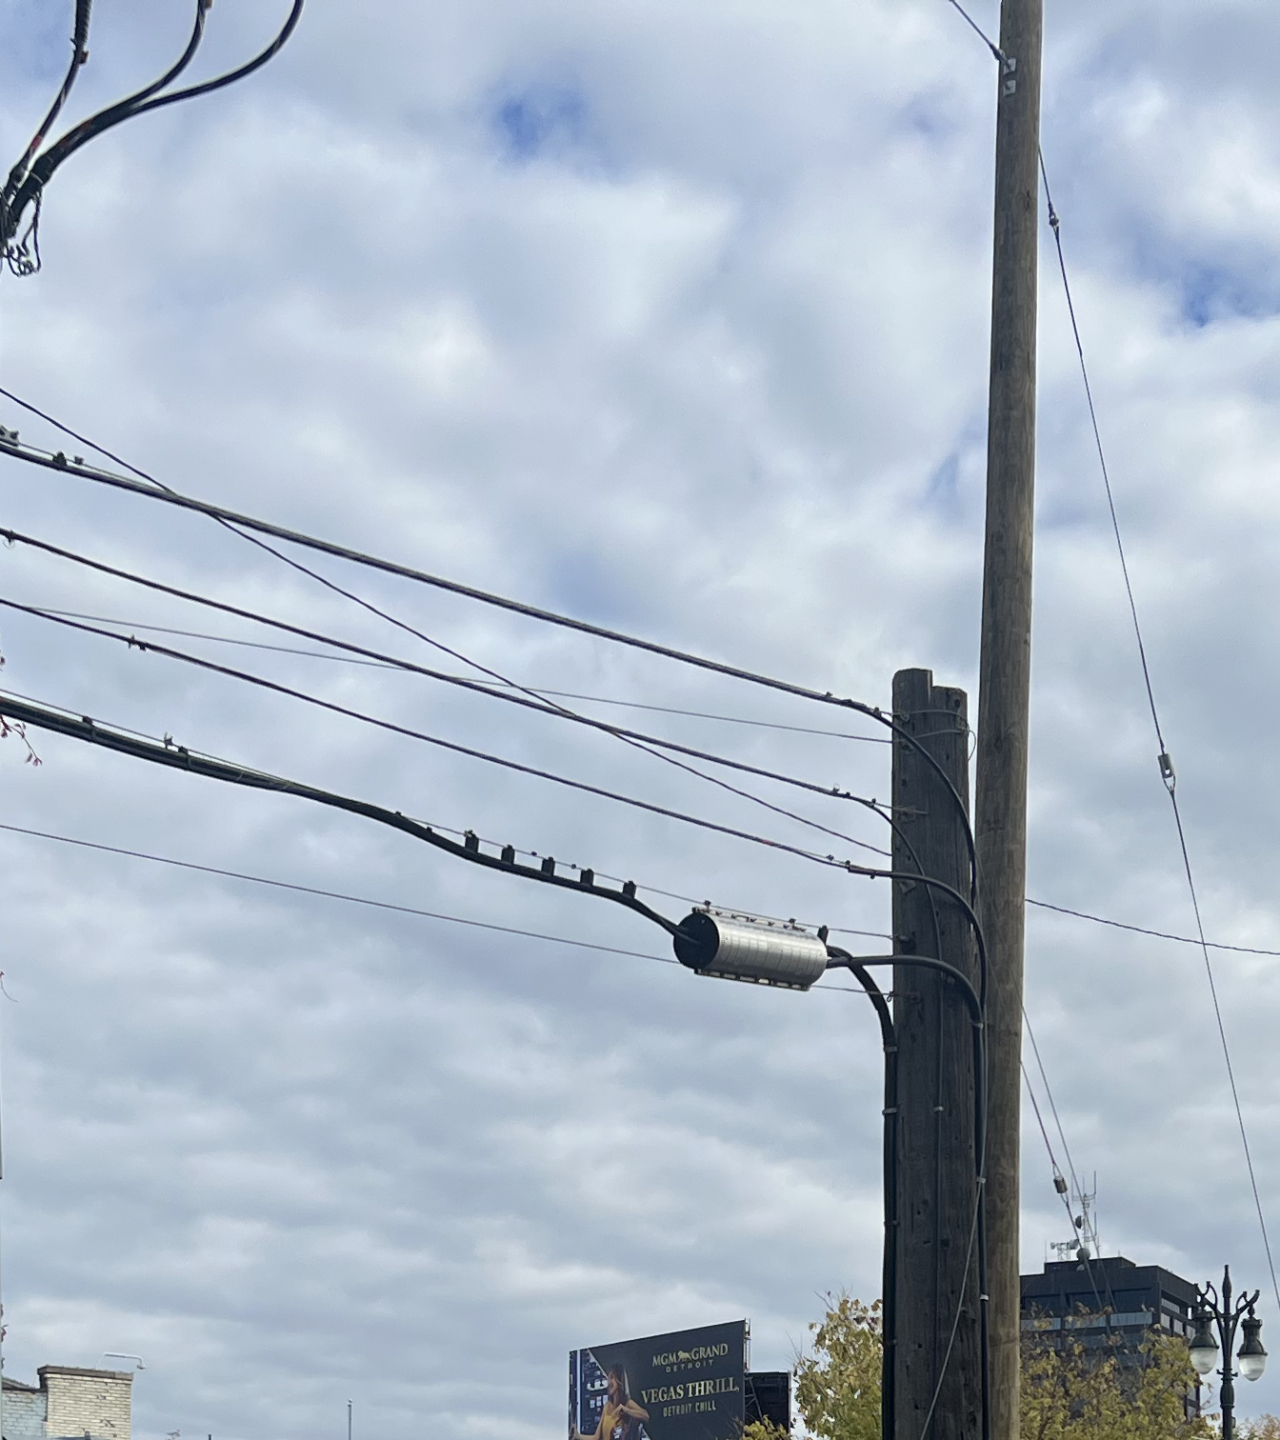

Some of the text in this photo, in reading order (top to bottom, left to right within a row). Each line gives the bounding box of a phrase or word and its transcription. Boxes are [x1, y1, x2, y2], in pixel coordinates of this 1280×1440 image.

[652, 1343, 728, 1367] MGM GRAND
[665, 1359, 714, 1373] DETROIT
[641, 1376, 739, 1404] VEGAS THRILL,
[663, 1399, 717, 1418] DETROIT CHILL
